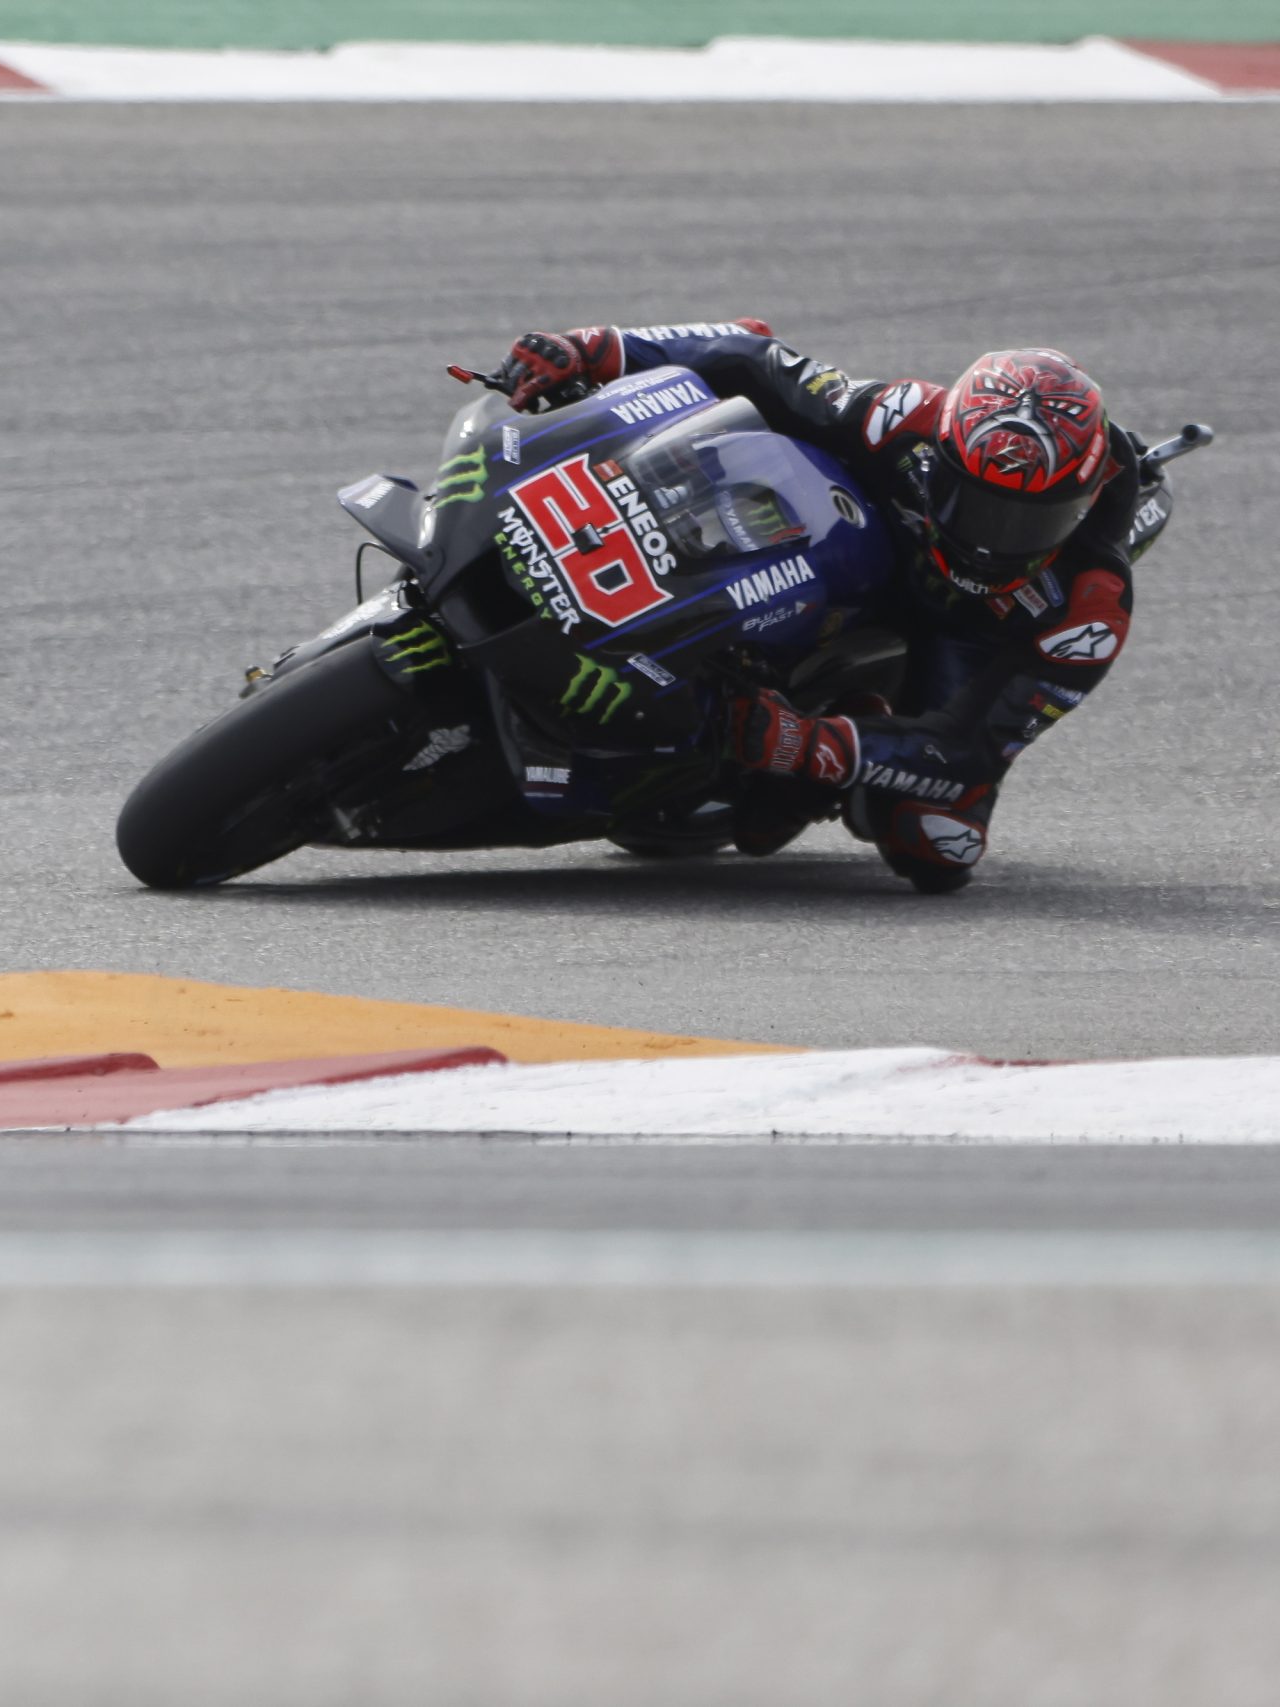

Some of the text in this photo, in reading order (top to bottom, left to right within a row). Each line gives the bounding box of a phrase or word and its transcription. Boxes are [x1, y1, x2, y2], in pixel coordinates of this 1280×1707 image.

[610, 380, 708, 424] YAMAHA
[497, 506, 581, 635] MONSTER
[508, 453, 674, 627] 20
[608, 475, 677, 577] ENEOS
[494, 532, 553, 621] ENERGY
[726, 554, 815, 610] YAMAHA
[863, 761, 965, 801] YAMAHA
